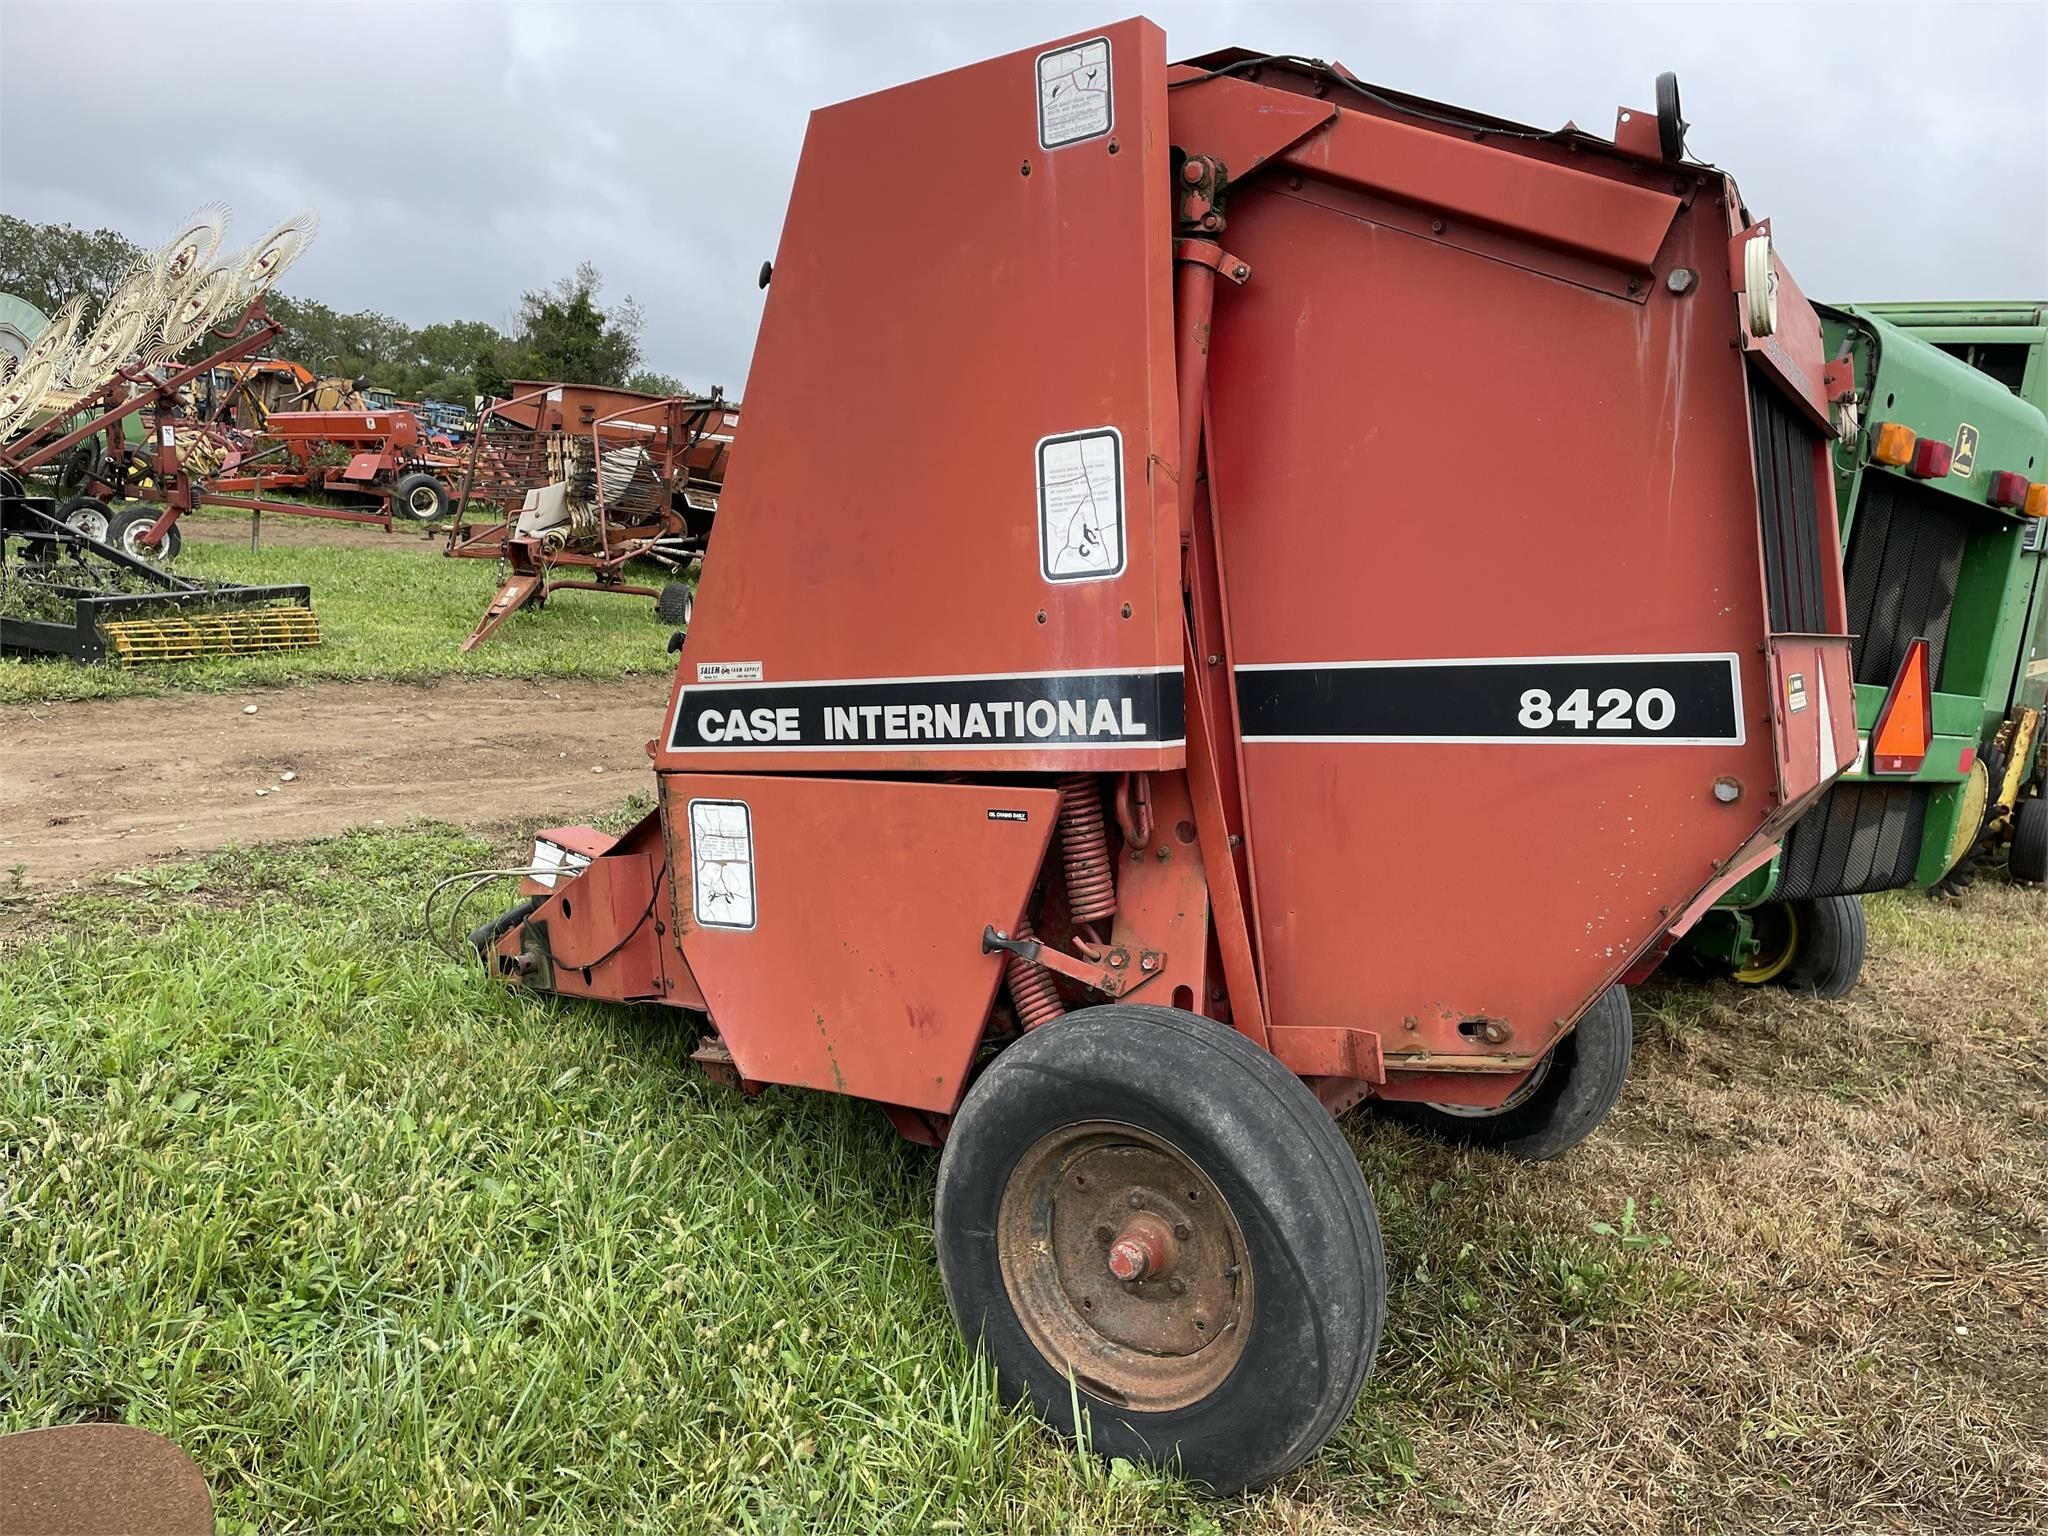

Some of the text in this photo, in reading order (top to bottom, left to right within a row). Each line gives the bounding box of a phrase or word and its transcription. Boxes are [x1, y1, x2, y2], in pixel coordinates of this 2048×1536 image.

[700, 666, 720, 674] SALEM
[697, 698, 1147, 742] CASE INTERNATIONAL
[1518, 688, 1676, 730] 8420
